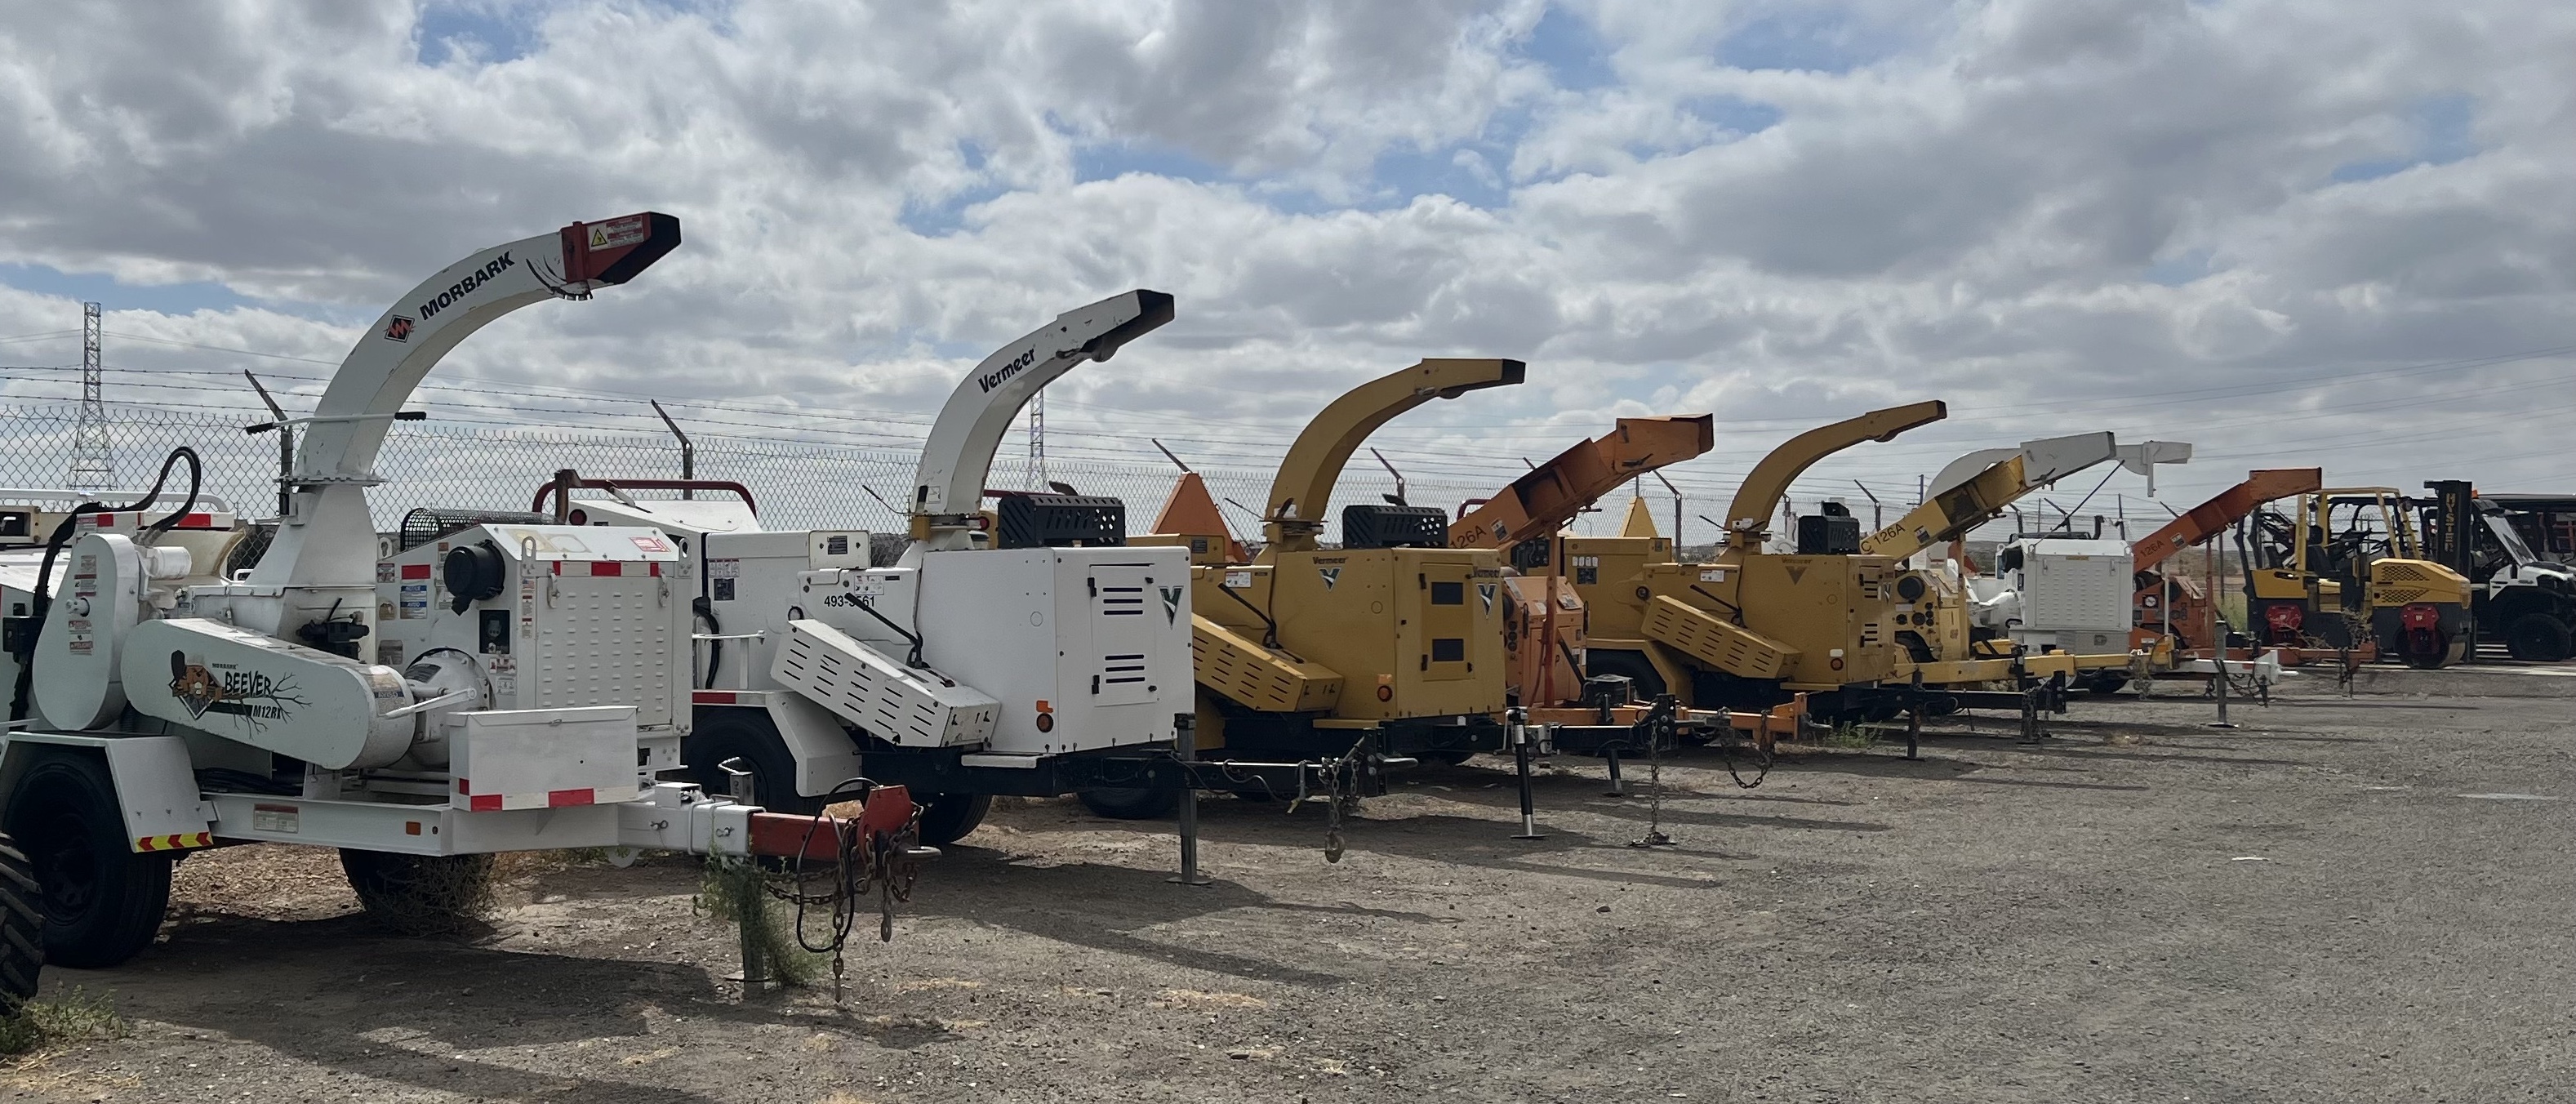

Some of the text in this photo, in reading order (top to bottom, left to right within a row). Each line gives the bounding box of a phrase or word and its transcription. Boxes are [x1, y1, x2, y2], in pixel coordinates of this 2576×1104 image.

[419, 251, 515, 321] MORBARK
[977, 348, 1035, 394] Vermeer
[2445, 492, 2456, 552] HYSTER
[1450, 525, 1487, 549] 126A
[1861, 523, 1906, 552] C 126A
[1312, 556, 1348, 564] Vermeer
[824, 595, 875, 608] 493-61
[225, 670, 271, 697] BEEVER
